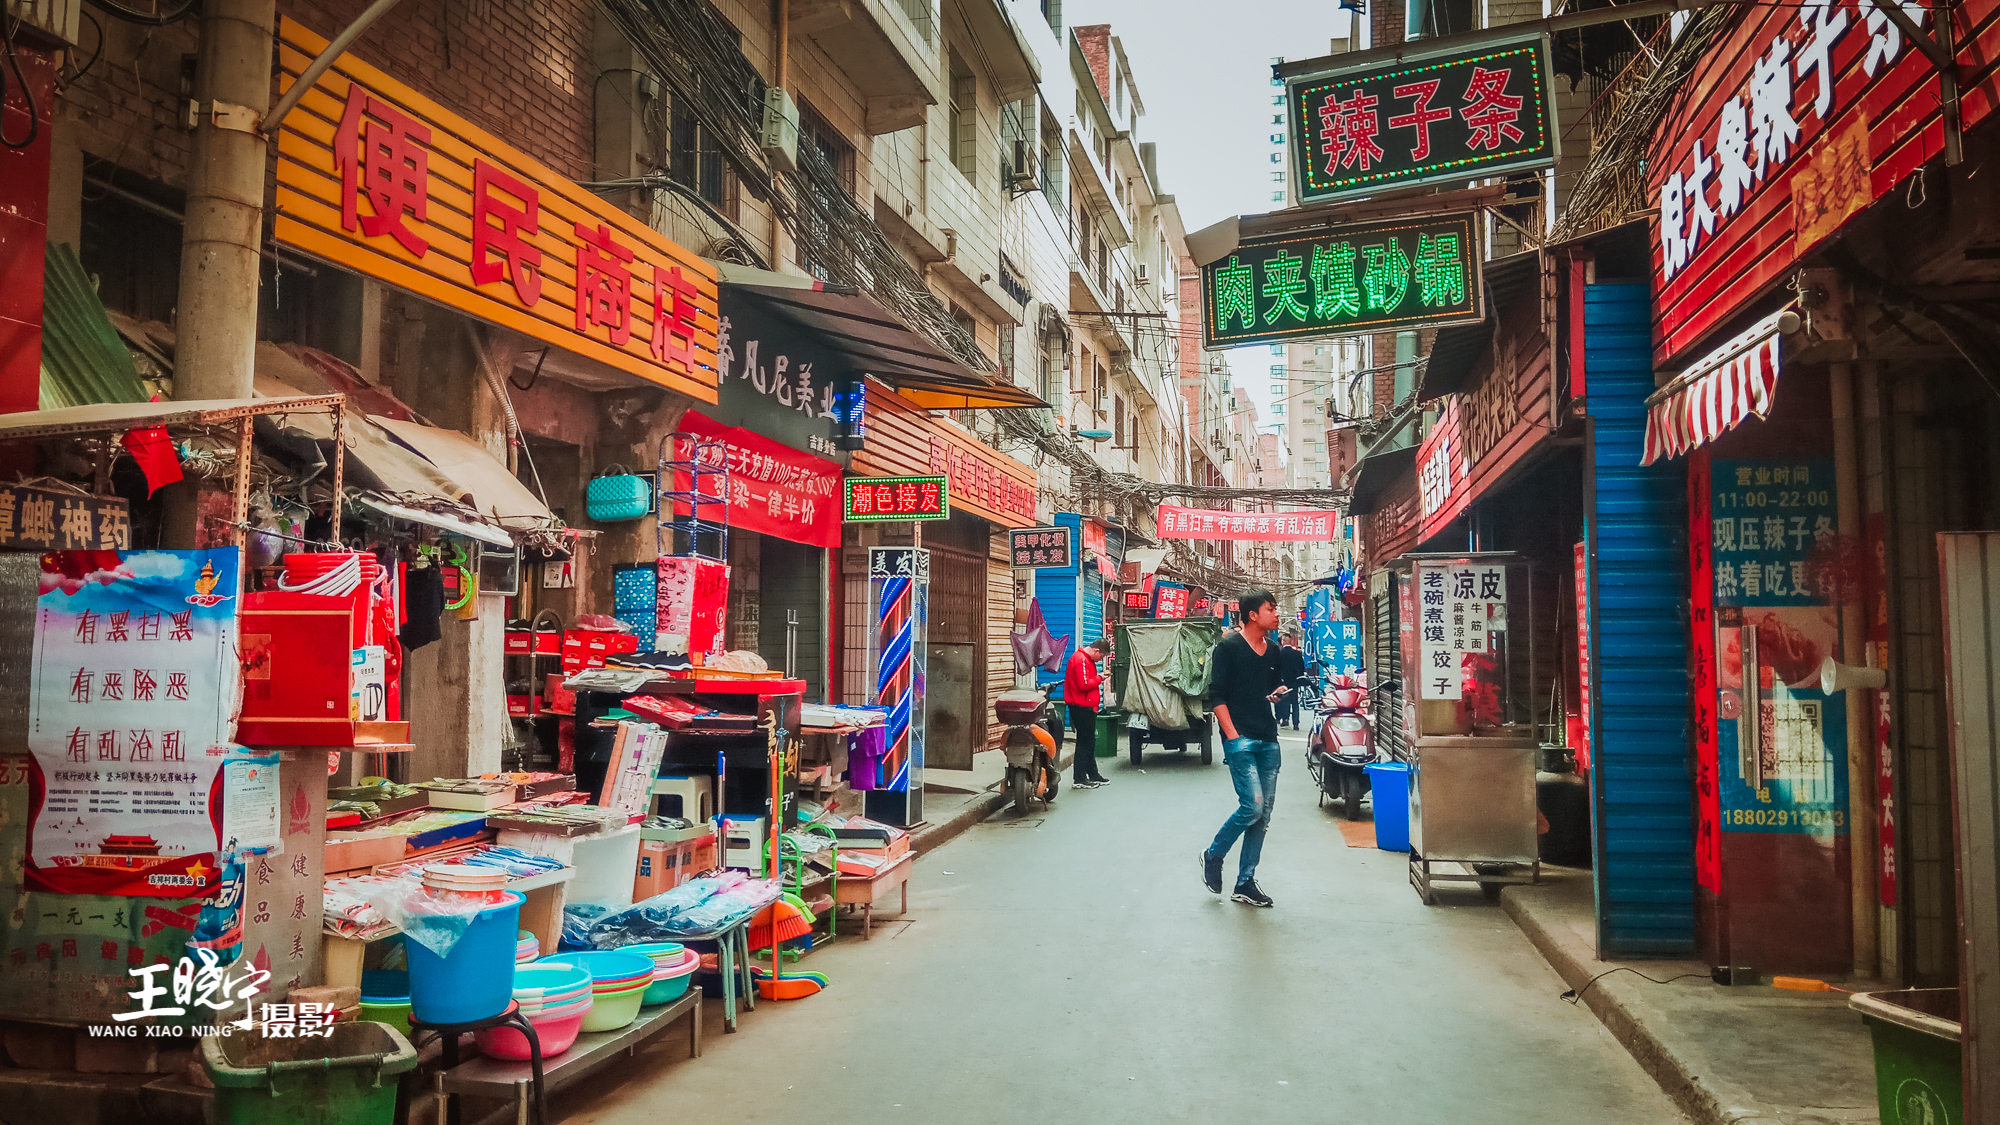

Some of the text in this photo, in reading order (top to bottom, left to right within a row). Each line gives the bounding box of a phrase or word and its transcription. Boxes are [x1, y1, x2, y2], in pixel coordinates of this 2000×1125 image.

[1318, 66, 1524, 177] 辣子条
[333, 83, 698, 374] 便民商店
[1215, 232, 1464, 331] 肉夹馍砂锅
[1736, 467, 1809, 485] 营业时间
[851, 483, 940, 513] 潮色接发
[1014, 533, 1064, 548] 美甲化妆
[1164, 512, 1328, 535] 有黑扫黑 有恶除恶 有乱治乱
[1713, 515, 1835, 551] 现压辣子条
[871, 551, 913, 575] 美发
[1716, 560, 1835, 597] 热着吃更
[1127, 594, 1148, 608] 照相
[1453, 569, 1503, 600] 凉皮
[1423, 572, 1445, 642] 老碗煮馍
[1322, 624, 1357, 640] 入网
[1453, 602, 1465, 650] 麻酱凉皮
[1470, 603, 1482, 649] 牛筋面
[1322, 643, 1358, 660] 专卖
[71, 667, 190, 704] 有恶除恶
[1432, 651, 1452, 695] 饺子
[67, 726, 185, 763] 有乱治乱
[149, 874, 194, 886] 吉祥村两委会
[253, 858, 274, 925] 食品
[43, 907, 129, 929] 一元一支
[288, 854, 309, 992] 健康美味
